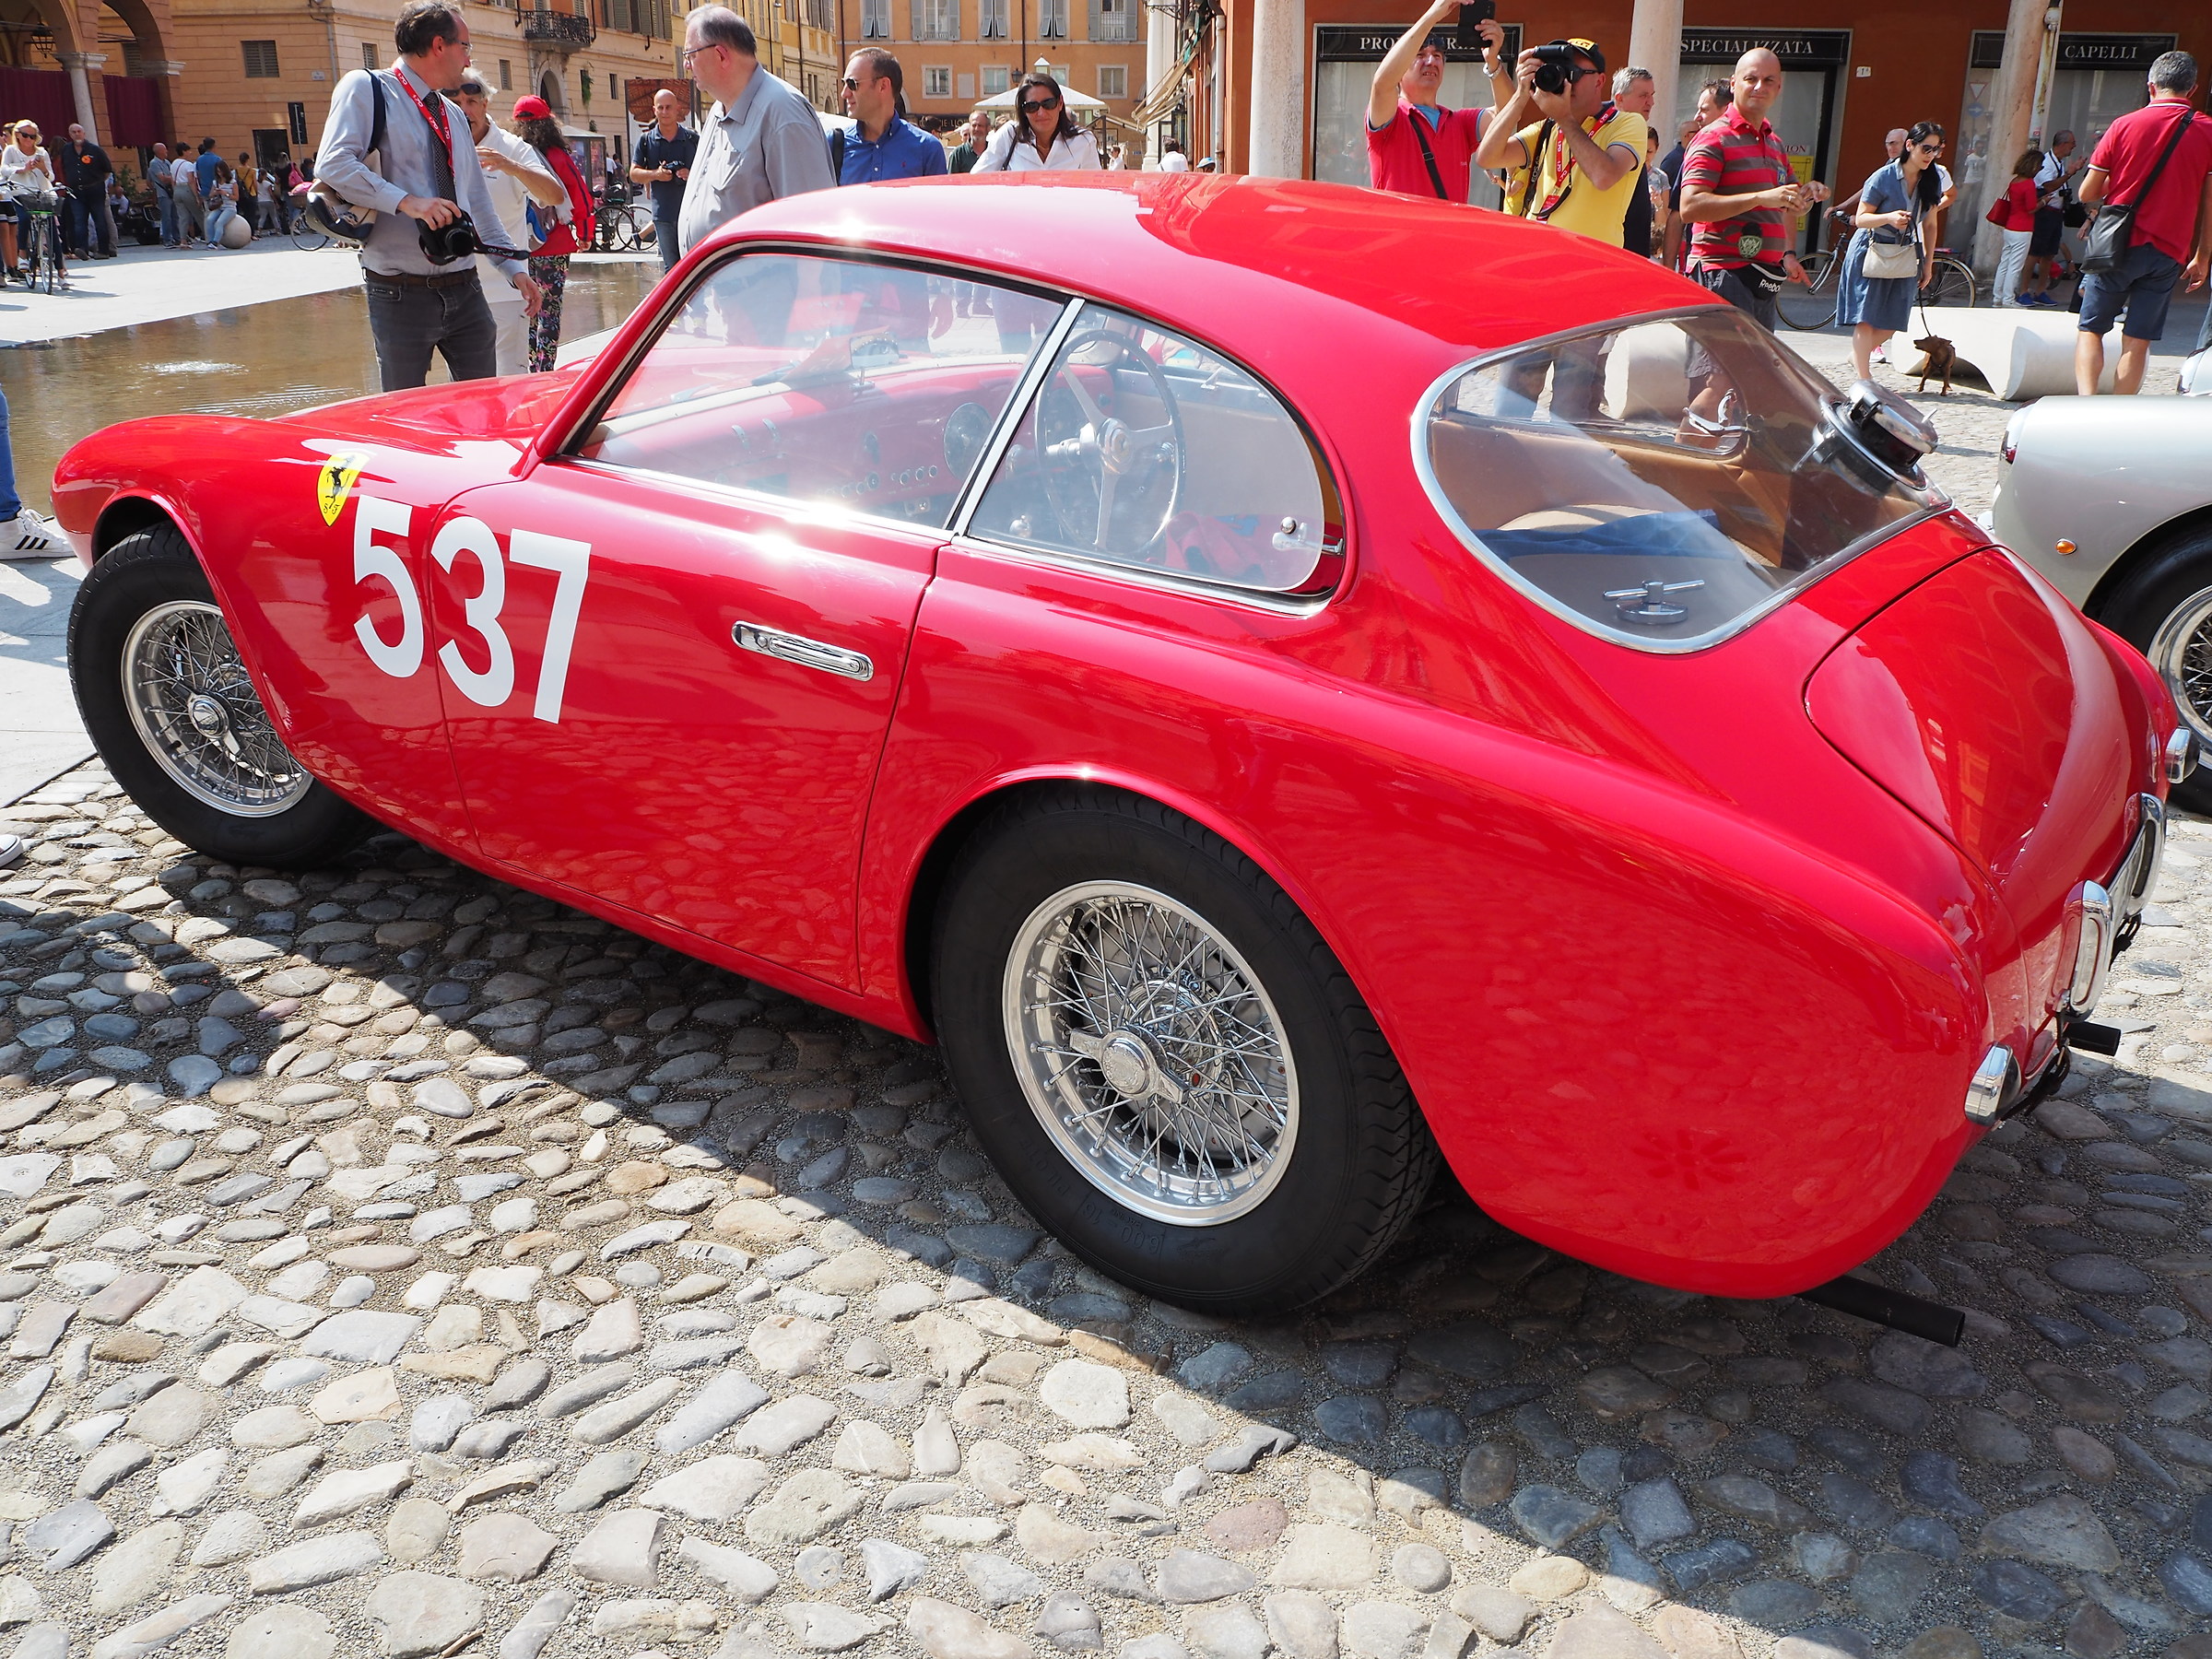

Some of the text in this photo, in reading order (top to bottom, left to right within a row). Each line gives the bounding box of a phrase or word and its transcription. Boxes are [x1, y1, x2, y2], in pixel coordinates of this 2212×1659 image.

[1681, 40, 1813, 54] SPECIALIZZATA
[2065, 45, 2137, 59] CAPELLI
[1759, 278, 1781, 293] Reebo
[354, 494, 592, 724] 537
